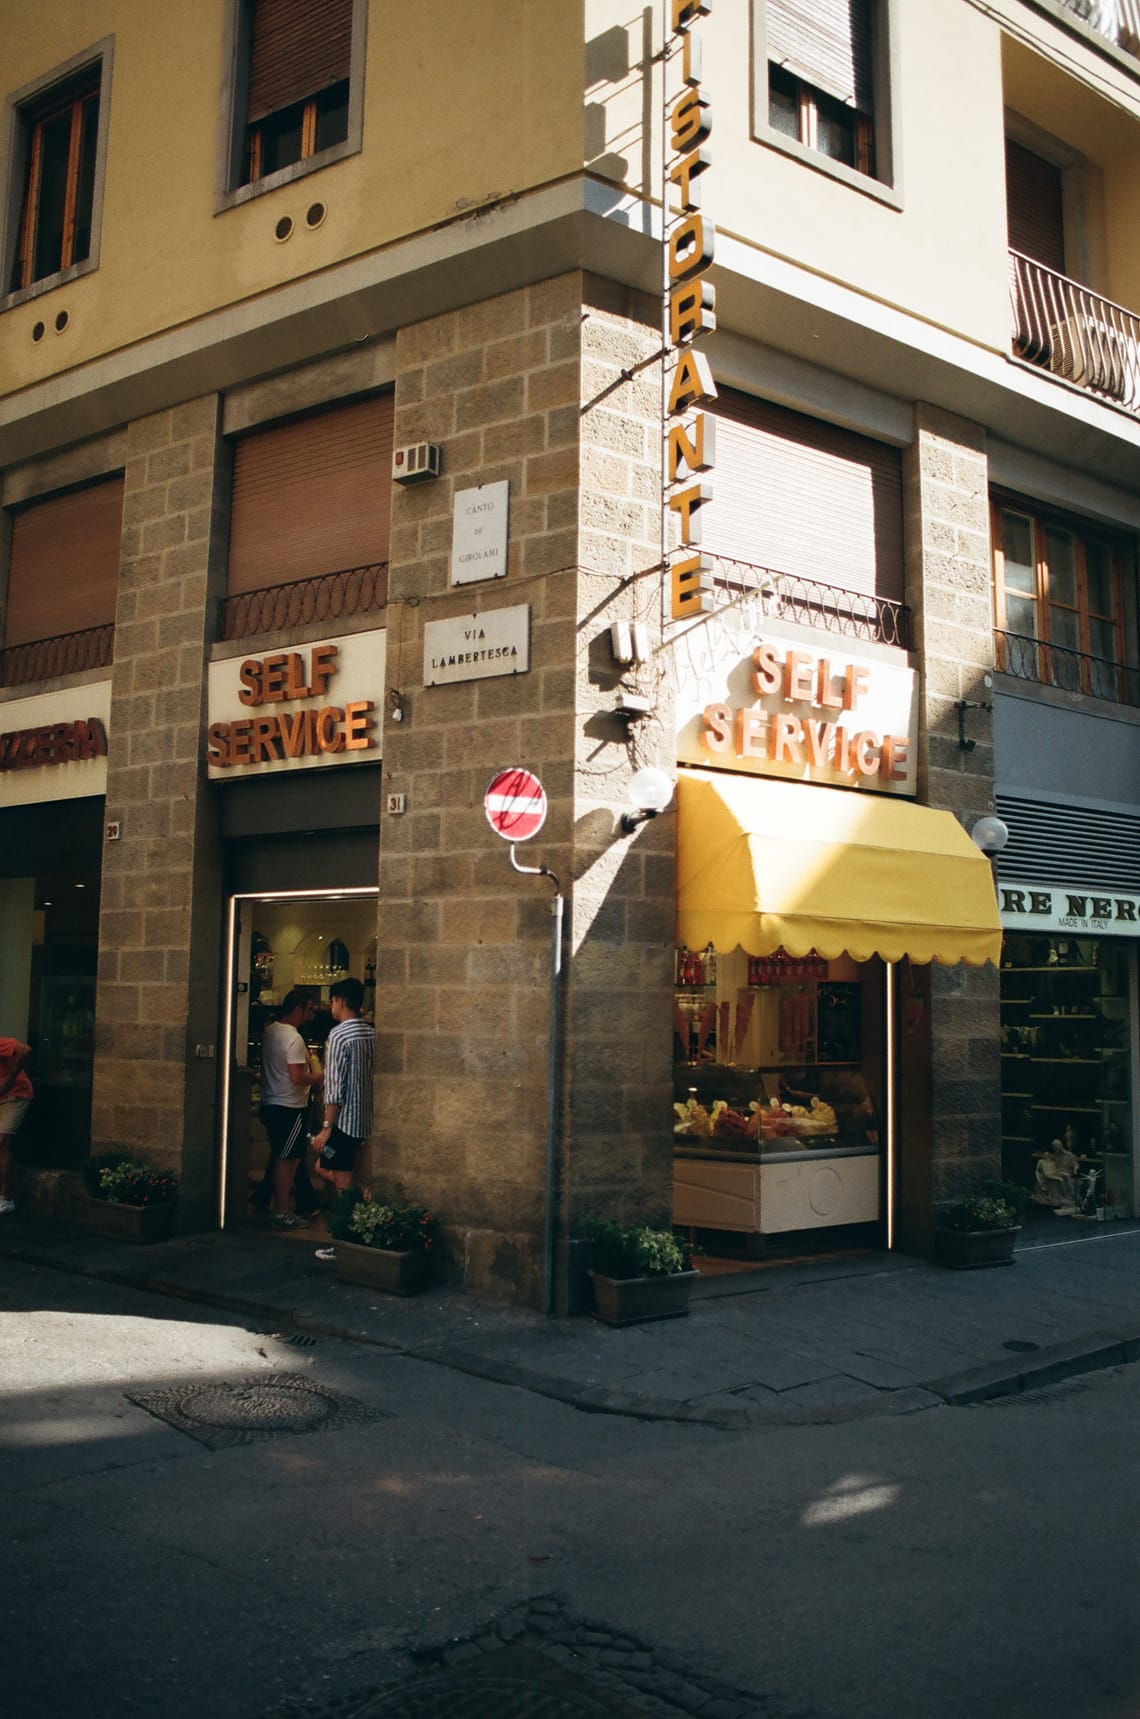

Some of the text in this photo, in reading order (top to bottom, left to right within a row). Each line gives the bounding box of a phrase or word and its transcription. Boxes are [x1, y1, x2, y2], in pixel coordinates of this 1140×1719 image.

[465, 502, 495, 516] CANTO
[458, 548, 499, 563] GIROLAMI
[464, 628, 486, 641] VIA
[431, 645, 518, 669] LAMBERTESCA
[238, 645, 338, 707] SELF
[752, 643, 871, 711] SELF
[0, 717, 108, 773] ZZERIA
[207, 701, 375, 768] SERVICE
[701, 702, 910, 781] SERVICE
[390, 797, 401, 811] 31
[1000, 888, 1140, 921] RE NER
[1058, 917, 1109, 930] MADE IN ITALY
